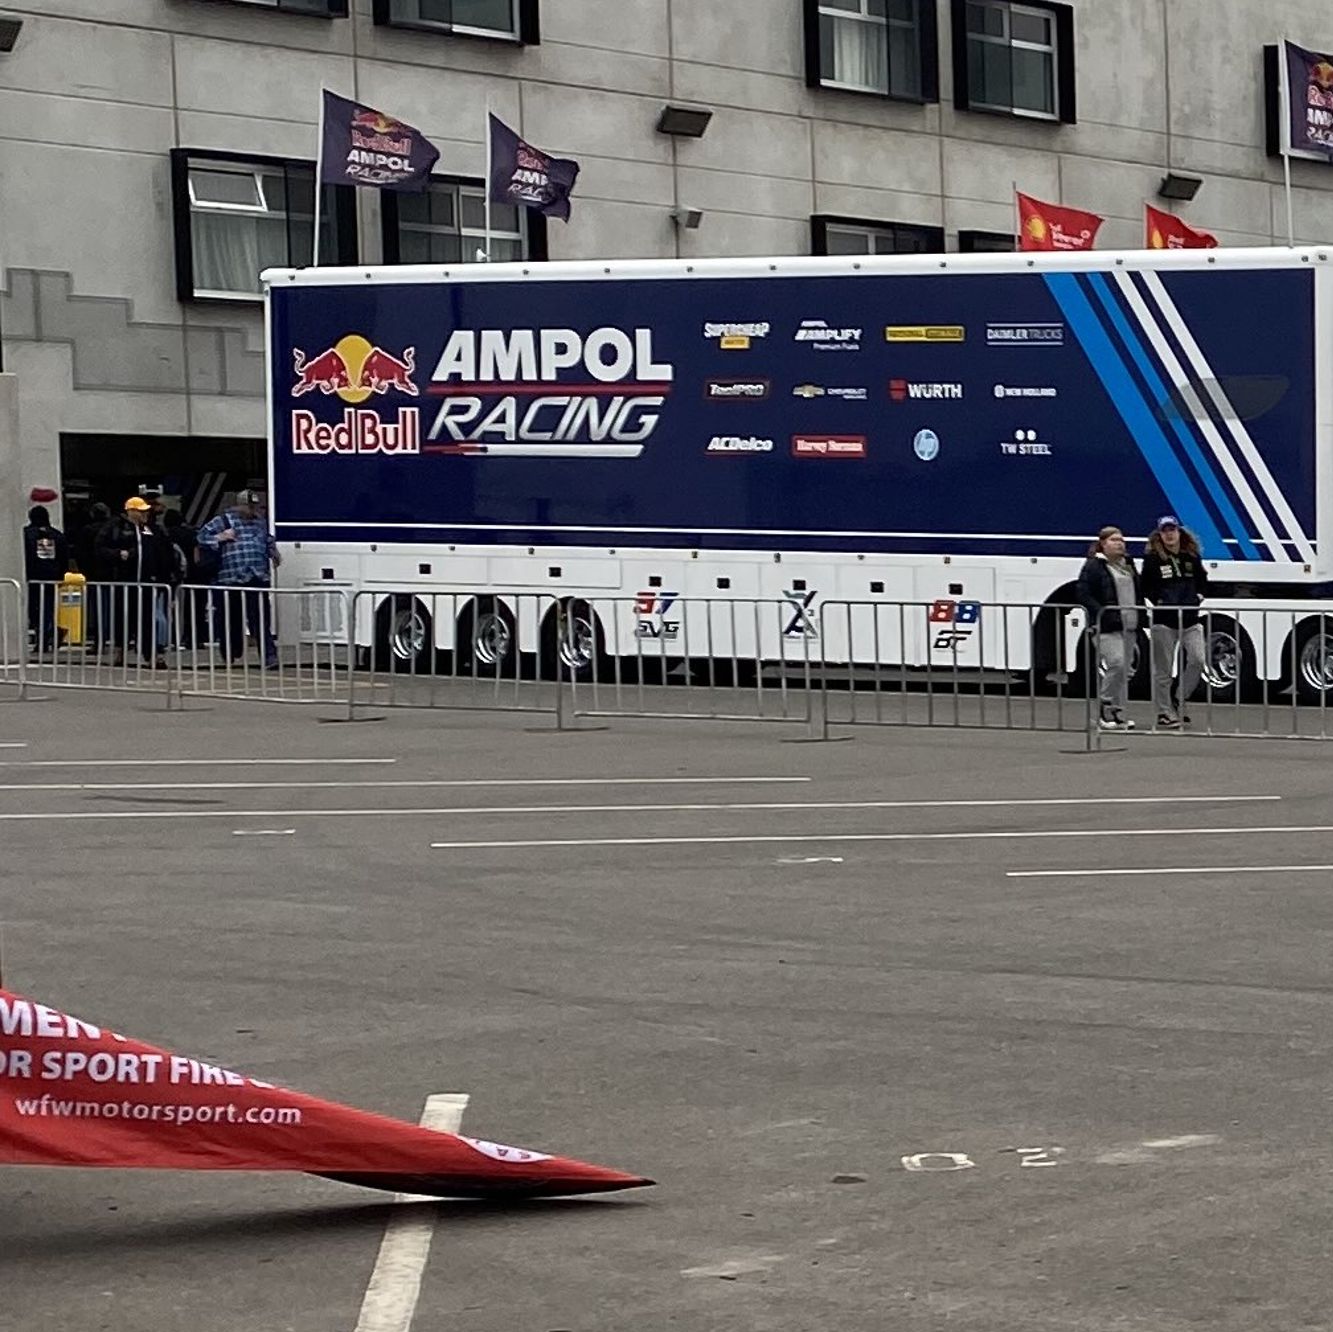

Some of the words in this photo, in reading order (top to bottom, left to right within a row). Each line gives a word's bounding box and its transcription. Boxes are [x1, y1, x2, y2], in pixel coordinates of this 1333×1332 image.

[347, 149, 414, 172] AMPOL
[431, 327, 673, 382] AMPOL
[292, 407, 354, 454] Red
[357, 406, 420, 454] Bull
[427, 396, 665, 441] RACING
[0, 1050, 31, 1078] R
[41, 1050, 163, 1083] SPORT
[170, 1055, 244, 1086] FIRE
[15, 1094, 301, 1125] wfwmotorsport.com
